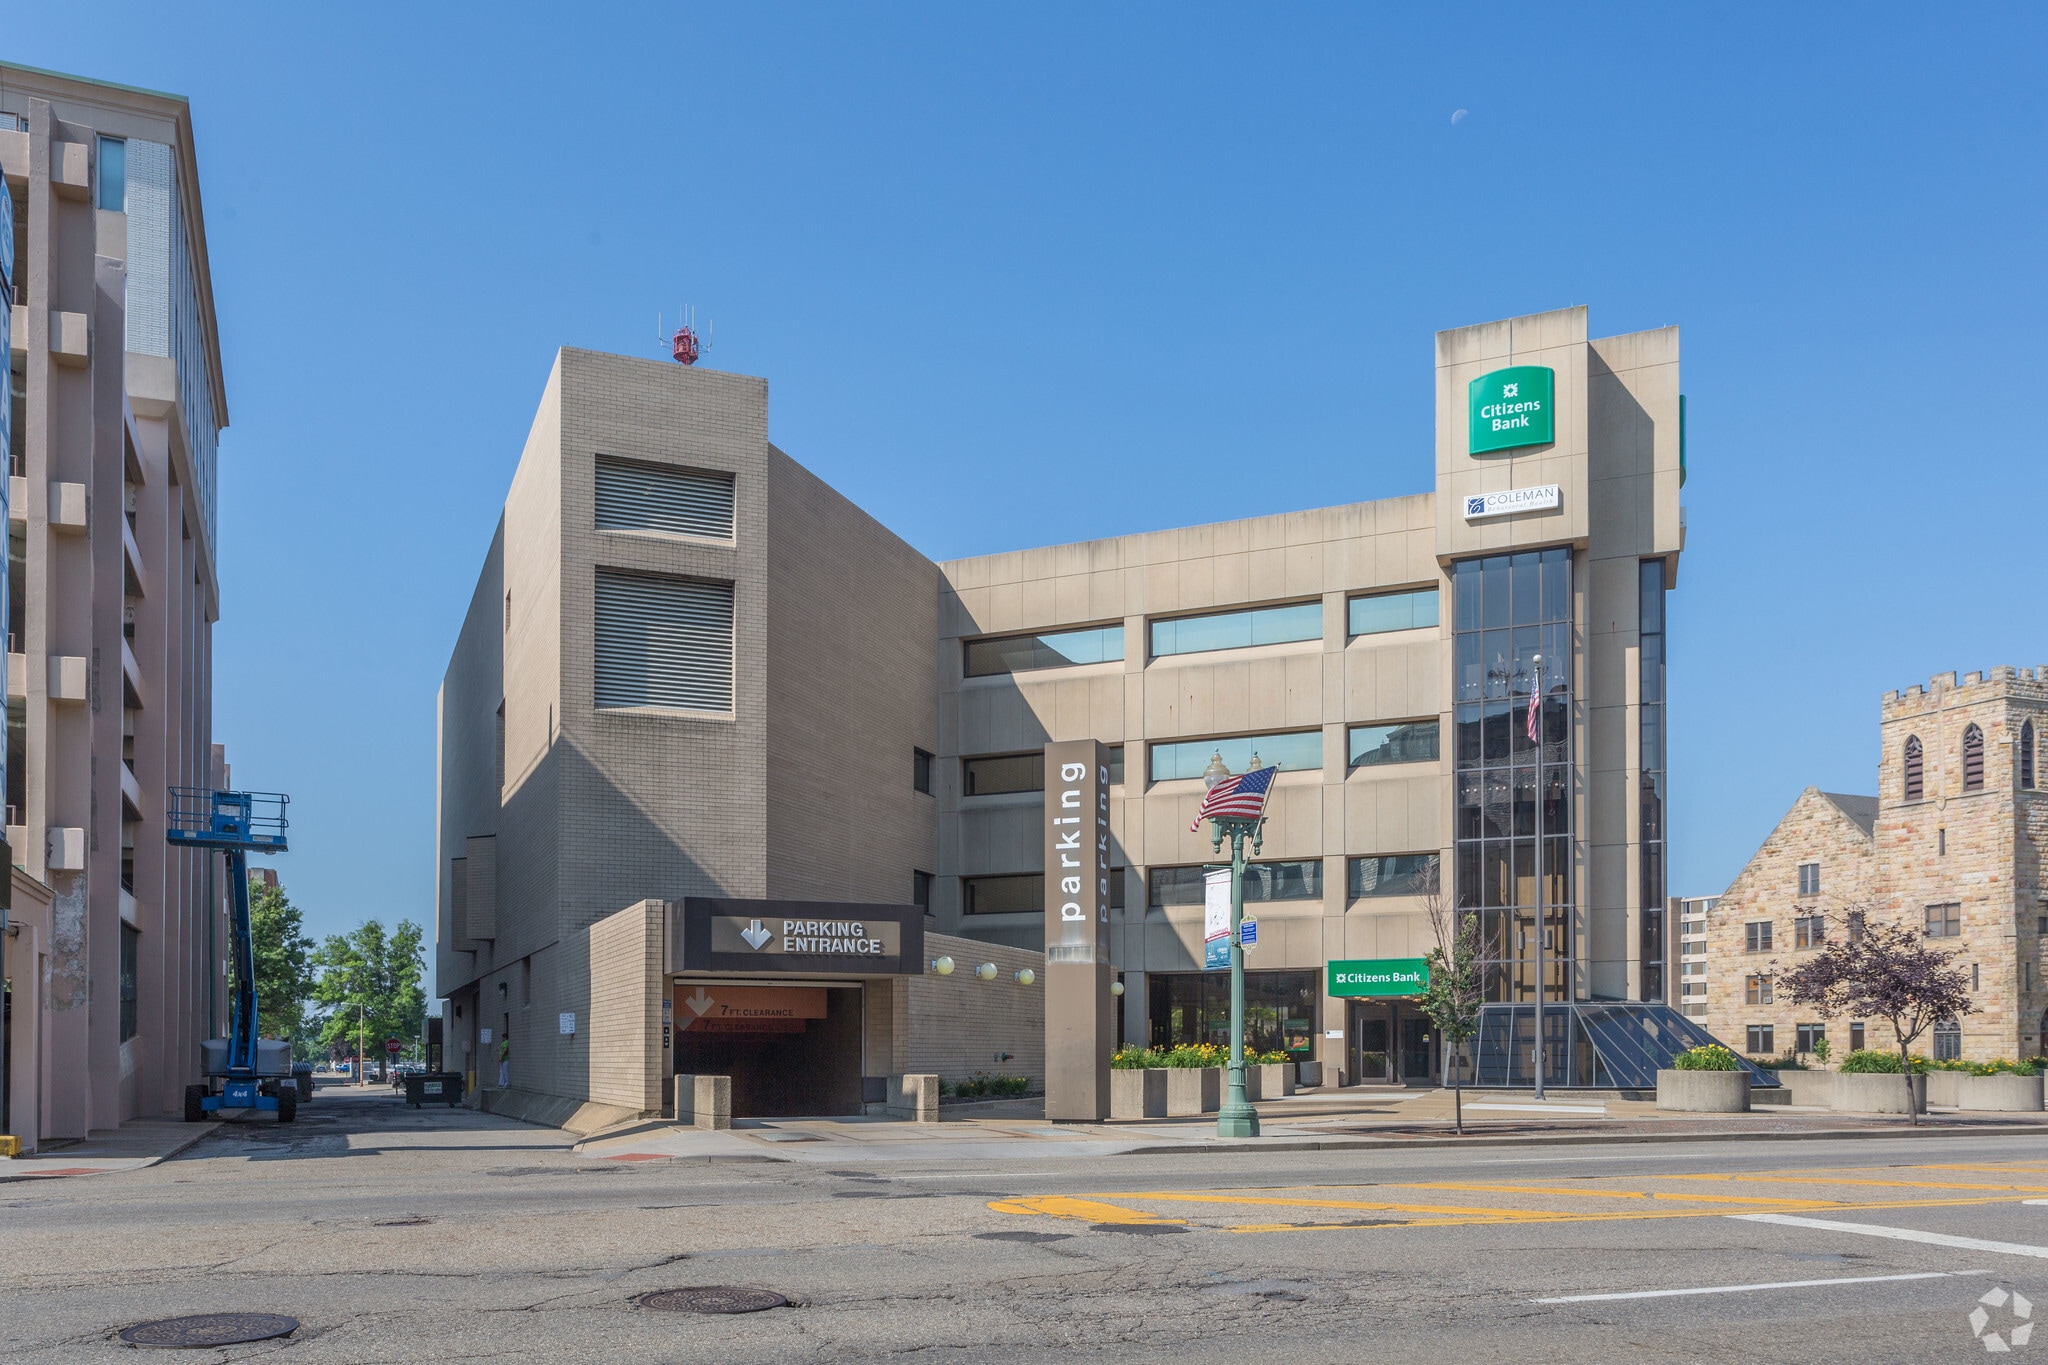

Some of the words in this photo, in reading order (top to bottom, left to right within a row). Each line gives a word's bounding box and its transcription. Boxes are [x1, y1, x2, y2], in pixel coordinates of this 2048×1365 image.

[1481, 400, 1540, 418] Citizens
[1492, 414, 1529, 431] Bank
[1487, 488, 1554, 506] COLEMAN
[1053, 762, 1086, 922] parking
[1098, 764, 1109, 923] parking
[783, 920, 864, 937] PARKING
[783, 937, 881, 954] ENTRANCE
[1347, 973, 1391, 983] Citizens
[1393, 971, 1420, 982] Bank
[721, 1005, 729, 1016] 7
[743, 1009, 793, 1017] CLEARANCE
[703, 1020, 710, 1030] 7
